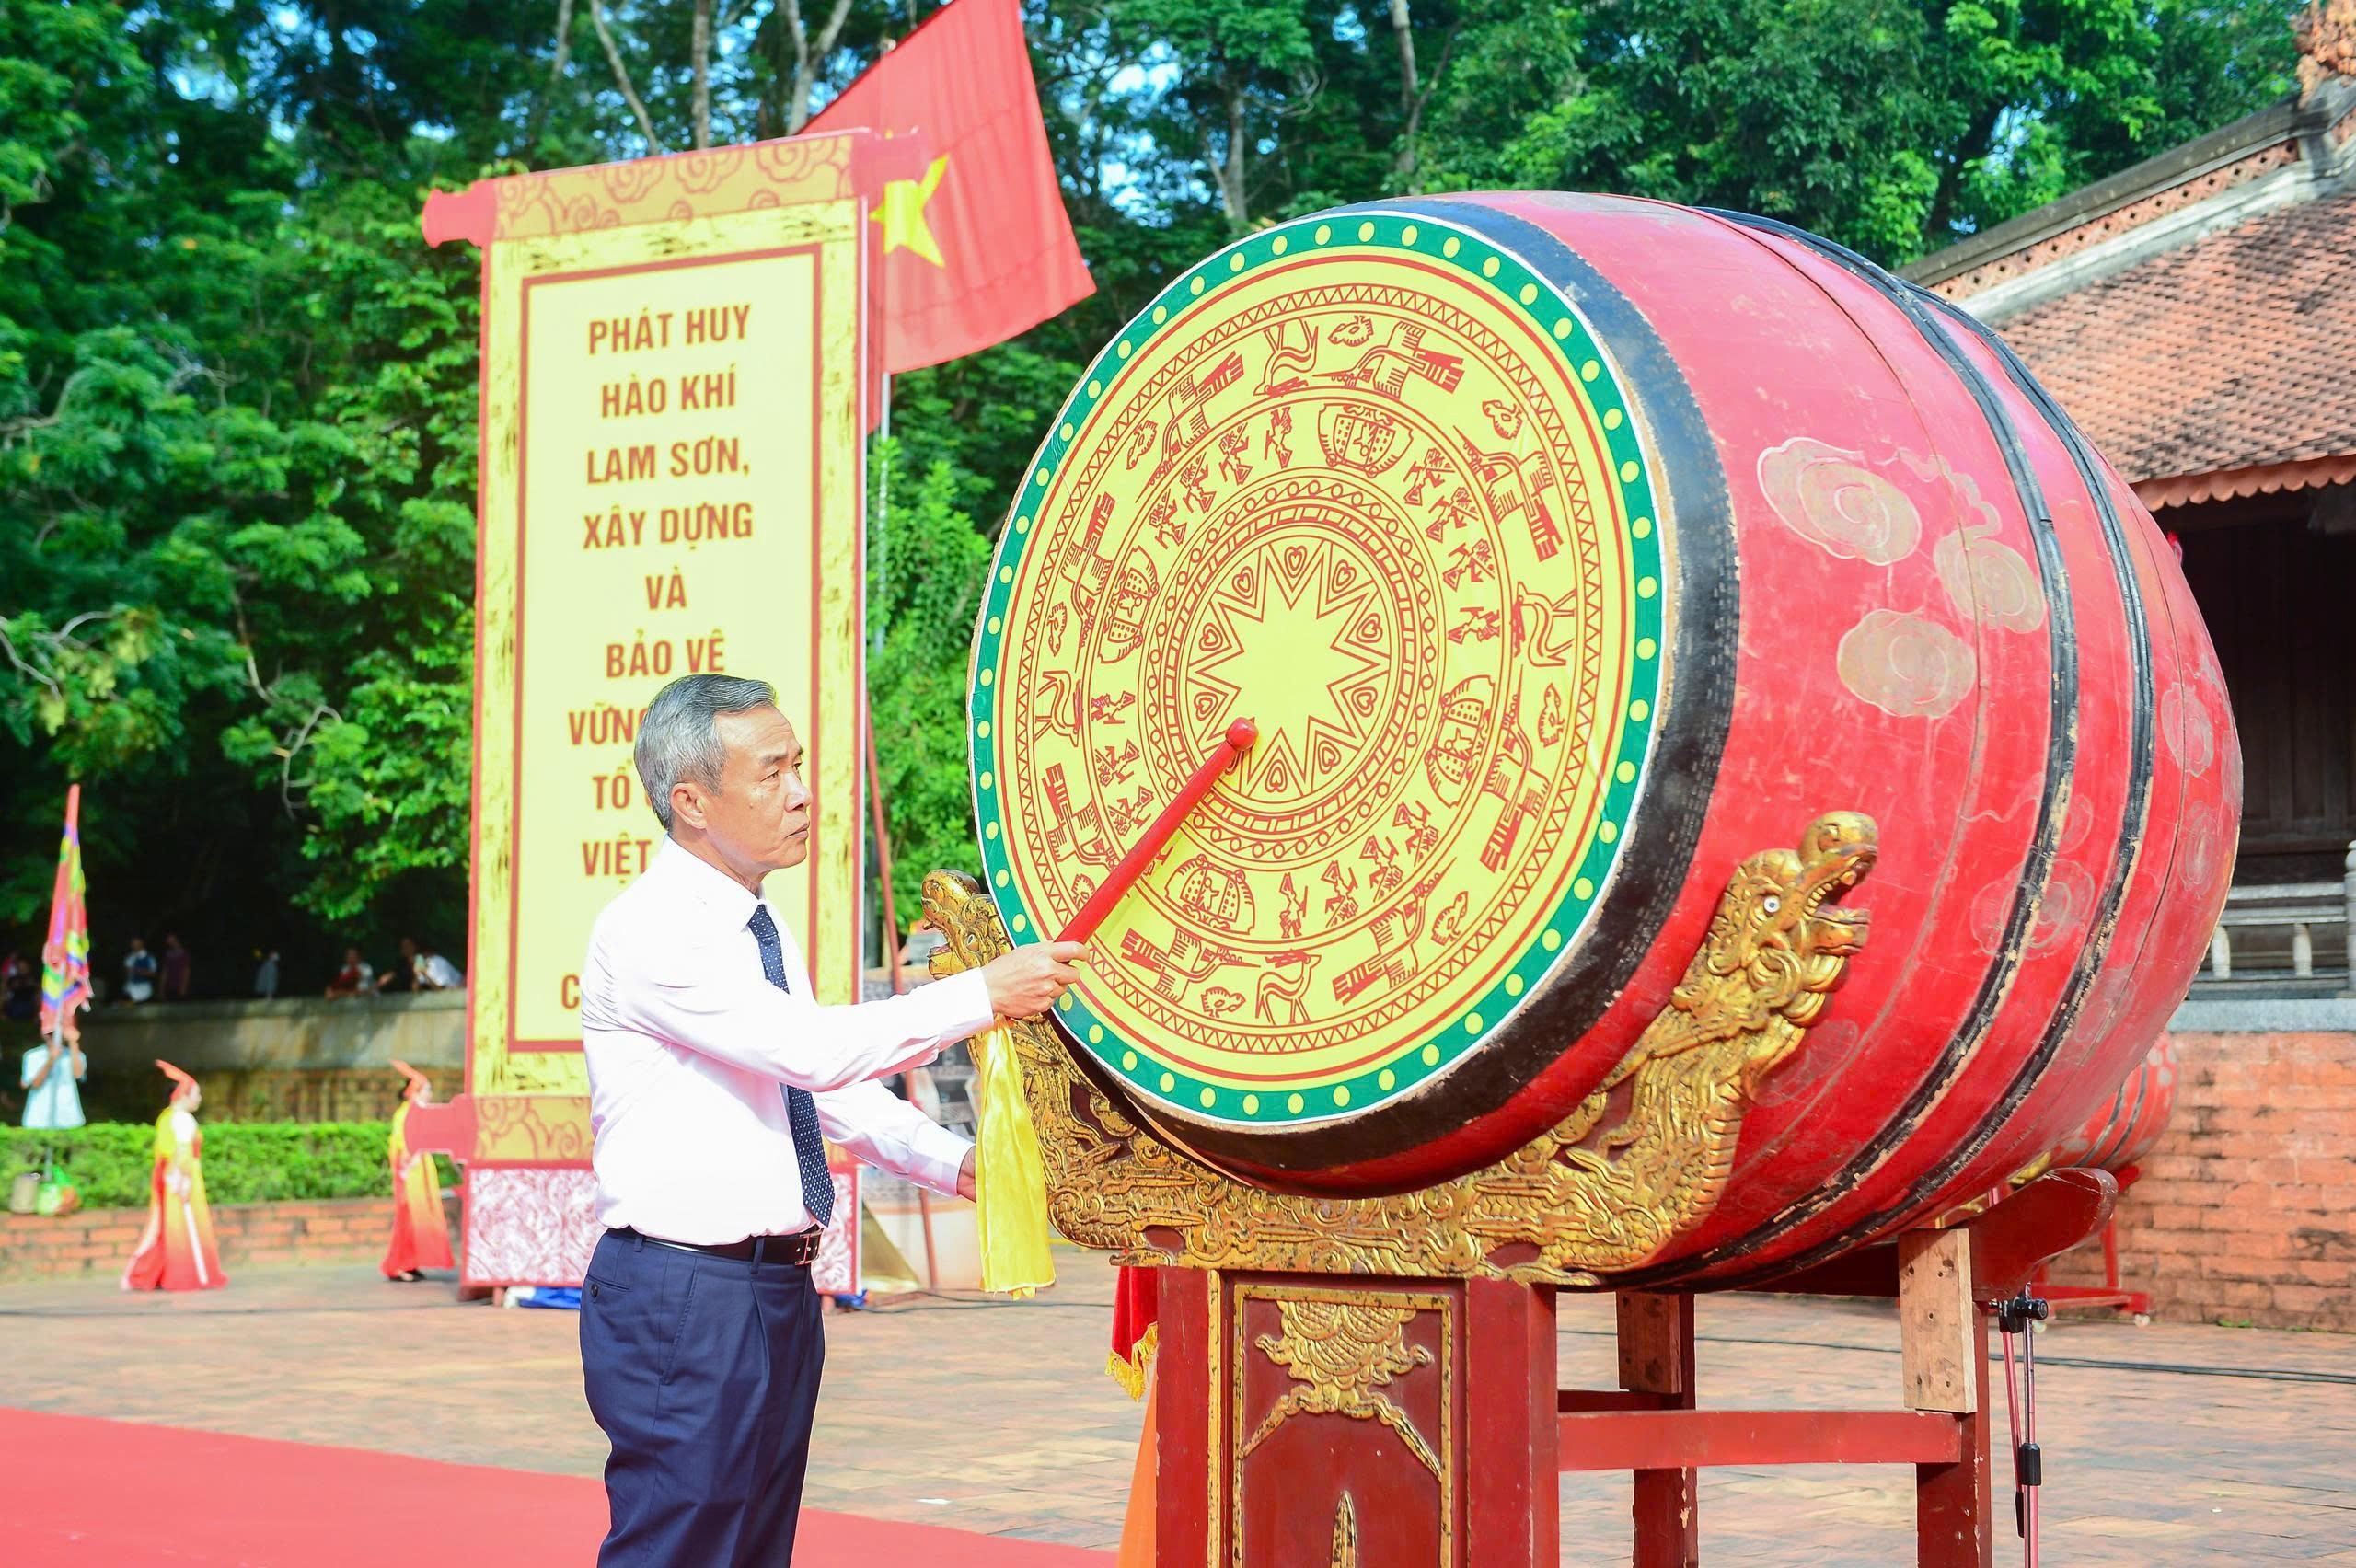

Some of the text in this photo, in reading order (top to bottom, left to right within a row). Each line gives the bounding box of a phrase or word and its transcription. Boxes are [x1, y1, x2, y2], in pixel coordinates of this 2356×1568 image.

[588, 304, 751, 355] PHÁT HUY
[601, 363, 736, 419] HÀO KHÍ
[586, 435, 750, 485] LAM SƠN,
[583, 502, 753, 551] XÂY DỰNG
[644, 564, 687, 611] VÀ
[606, 628, 673, 678] BẢO
[582, 831, 653, 884] VIỆT
